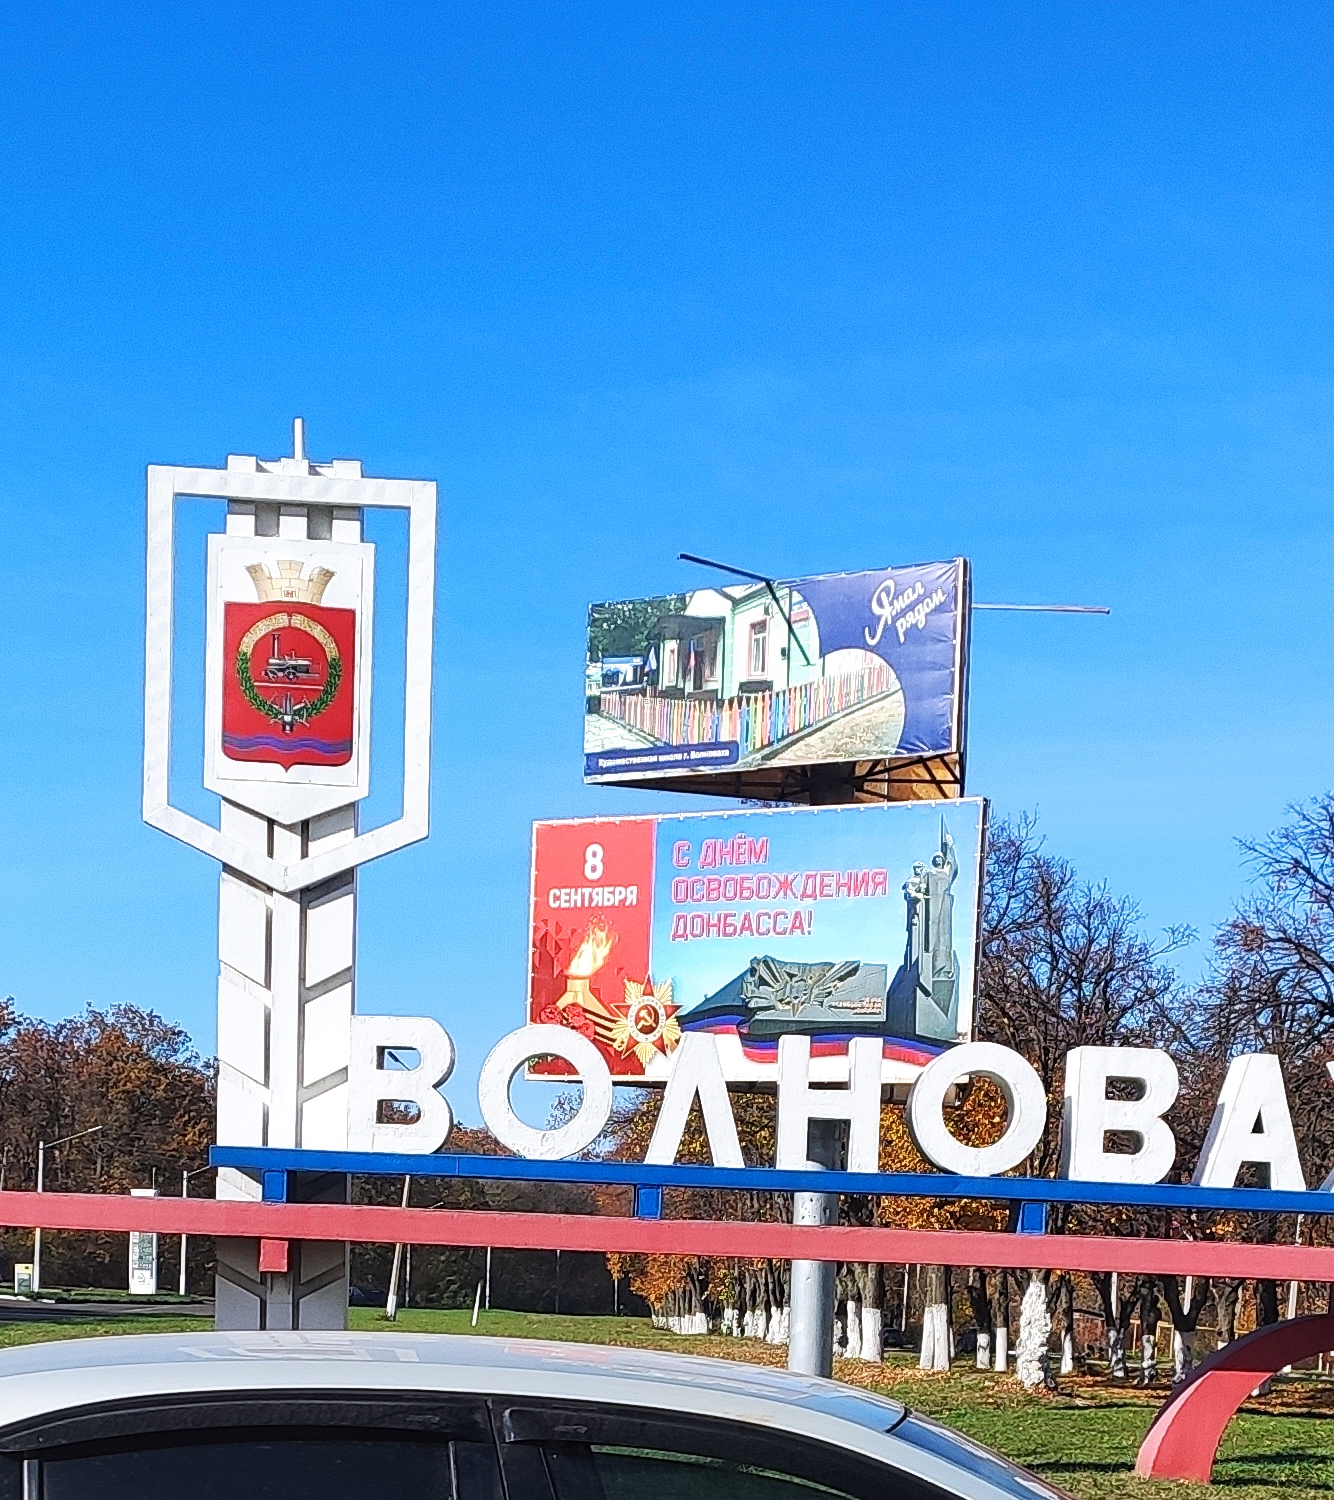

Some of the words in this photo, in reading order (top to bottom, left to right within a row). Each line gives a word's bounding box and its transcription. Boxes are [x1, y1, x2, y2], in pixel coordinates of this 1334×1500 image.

[864, 578, 925, 646] Ямал
[896, 586, 948, 644] рядом
[584, 843, 604, 881] 8
[673, 841, 691, 867] С
[699, 833, 769, 869] ДНЁМ
[548, 885, 638, 909] СЕНТЯБРЯ
[672, 870, 888, 903] ОСВОБОЖДЕНИЯ
[671, 909, 813, 941] ДОНБАССА!
